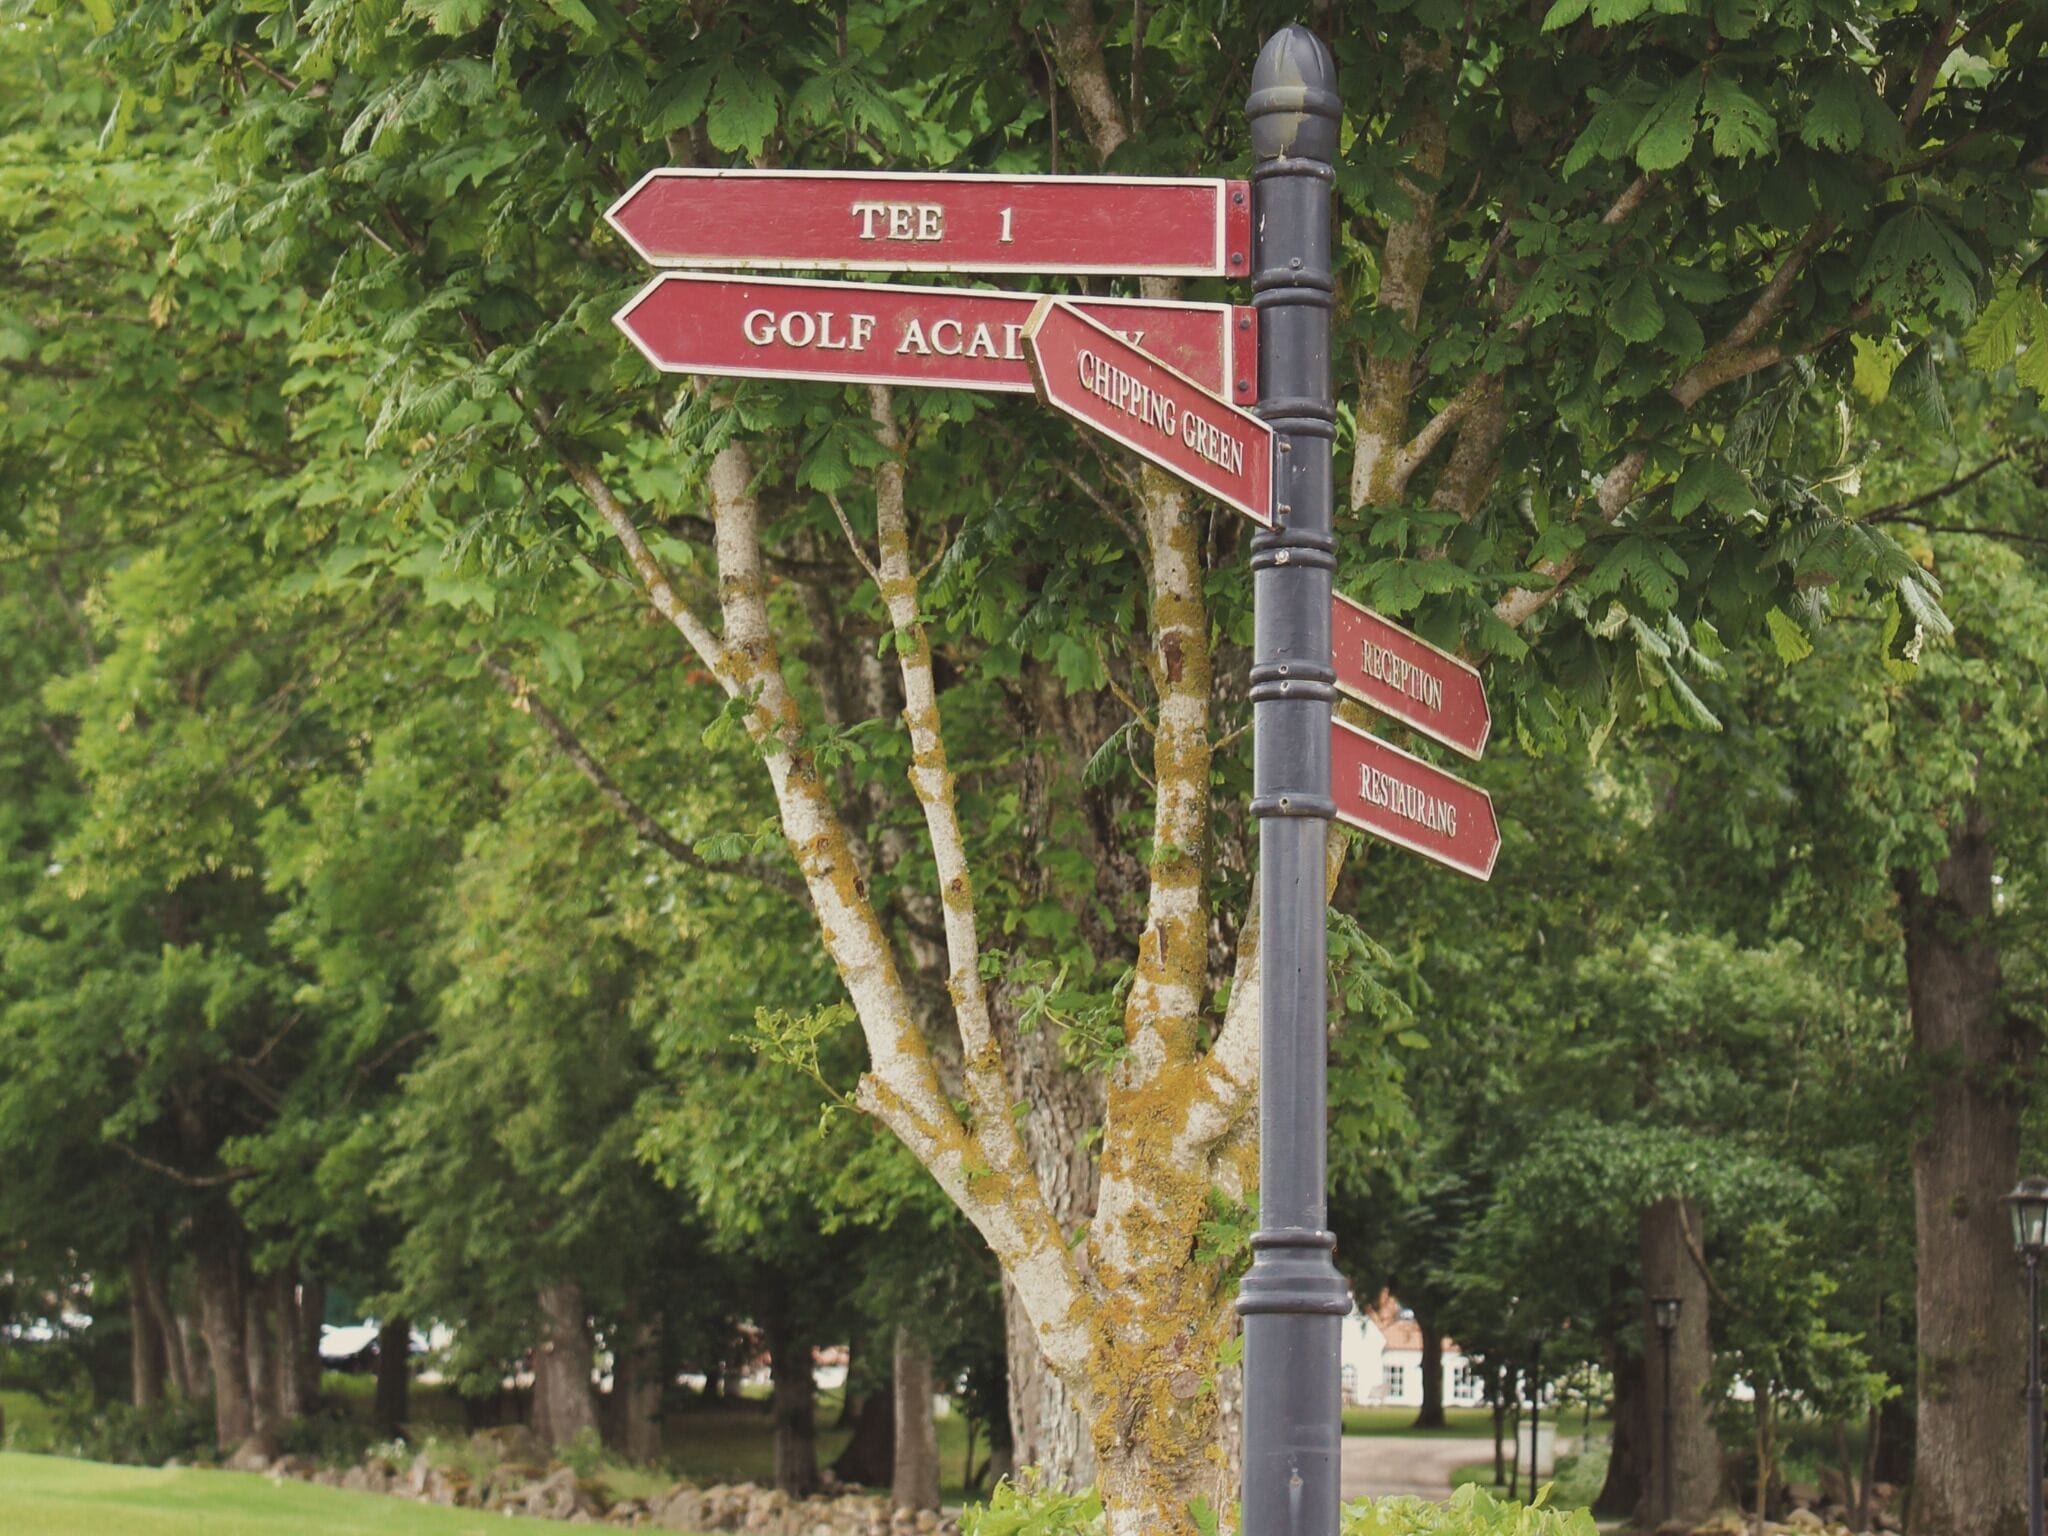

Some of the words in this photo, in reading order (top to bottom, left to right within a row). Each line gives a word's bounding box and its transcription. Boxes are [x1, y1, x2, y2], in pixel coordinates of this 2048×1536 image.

[852, 203, 943, 241] TEE
[1000, 207, 1014, 242] 1
[743, 309, 876, 351] GOLF
[896, 318, 1145, 361] ACAD
[1078, 350, 1176, 437] CHIPPING
[1182, 410, 1244, 477] GREEN
[1361, 639, 1442, 713] RECEPTION
[1359, 763, 1457, 838] RESTAURANG
